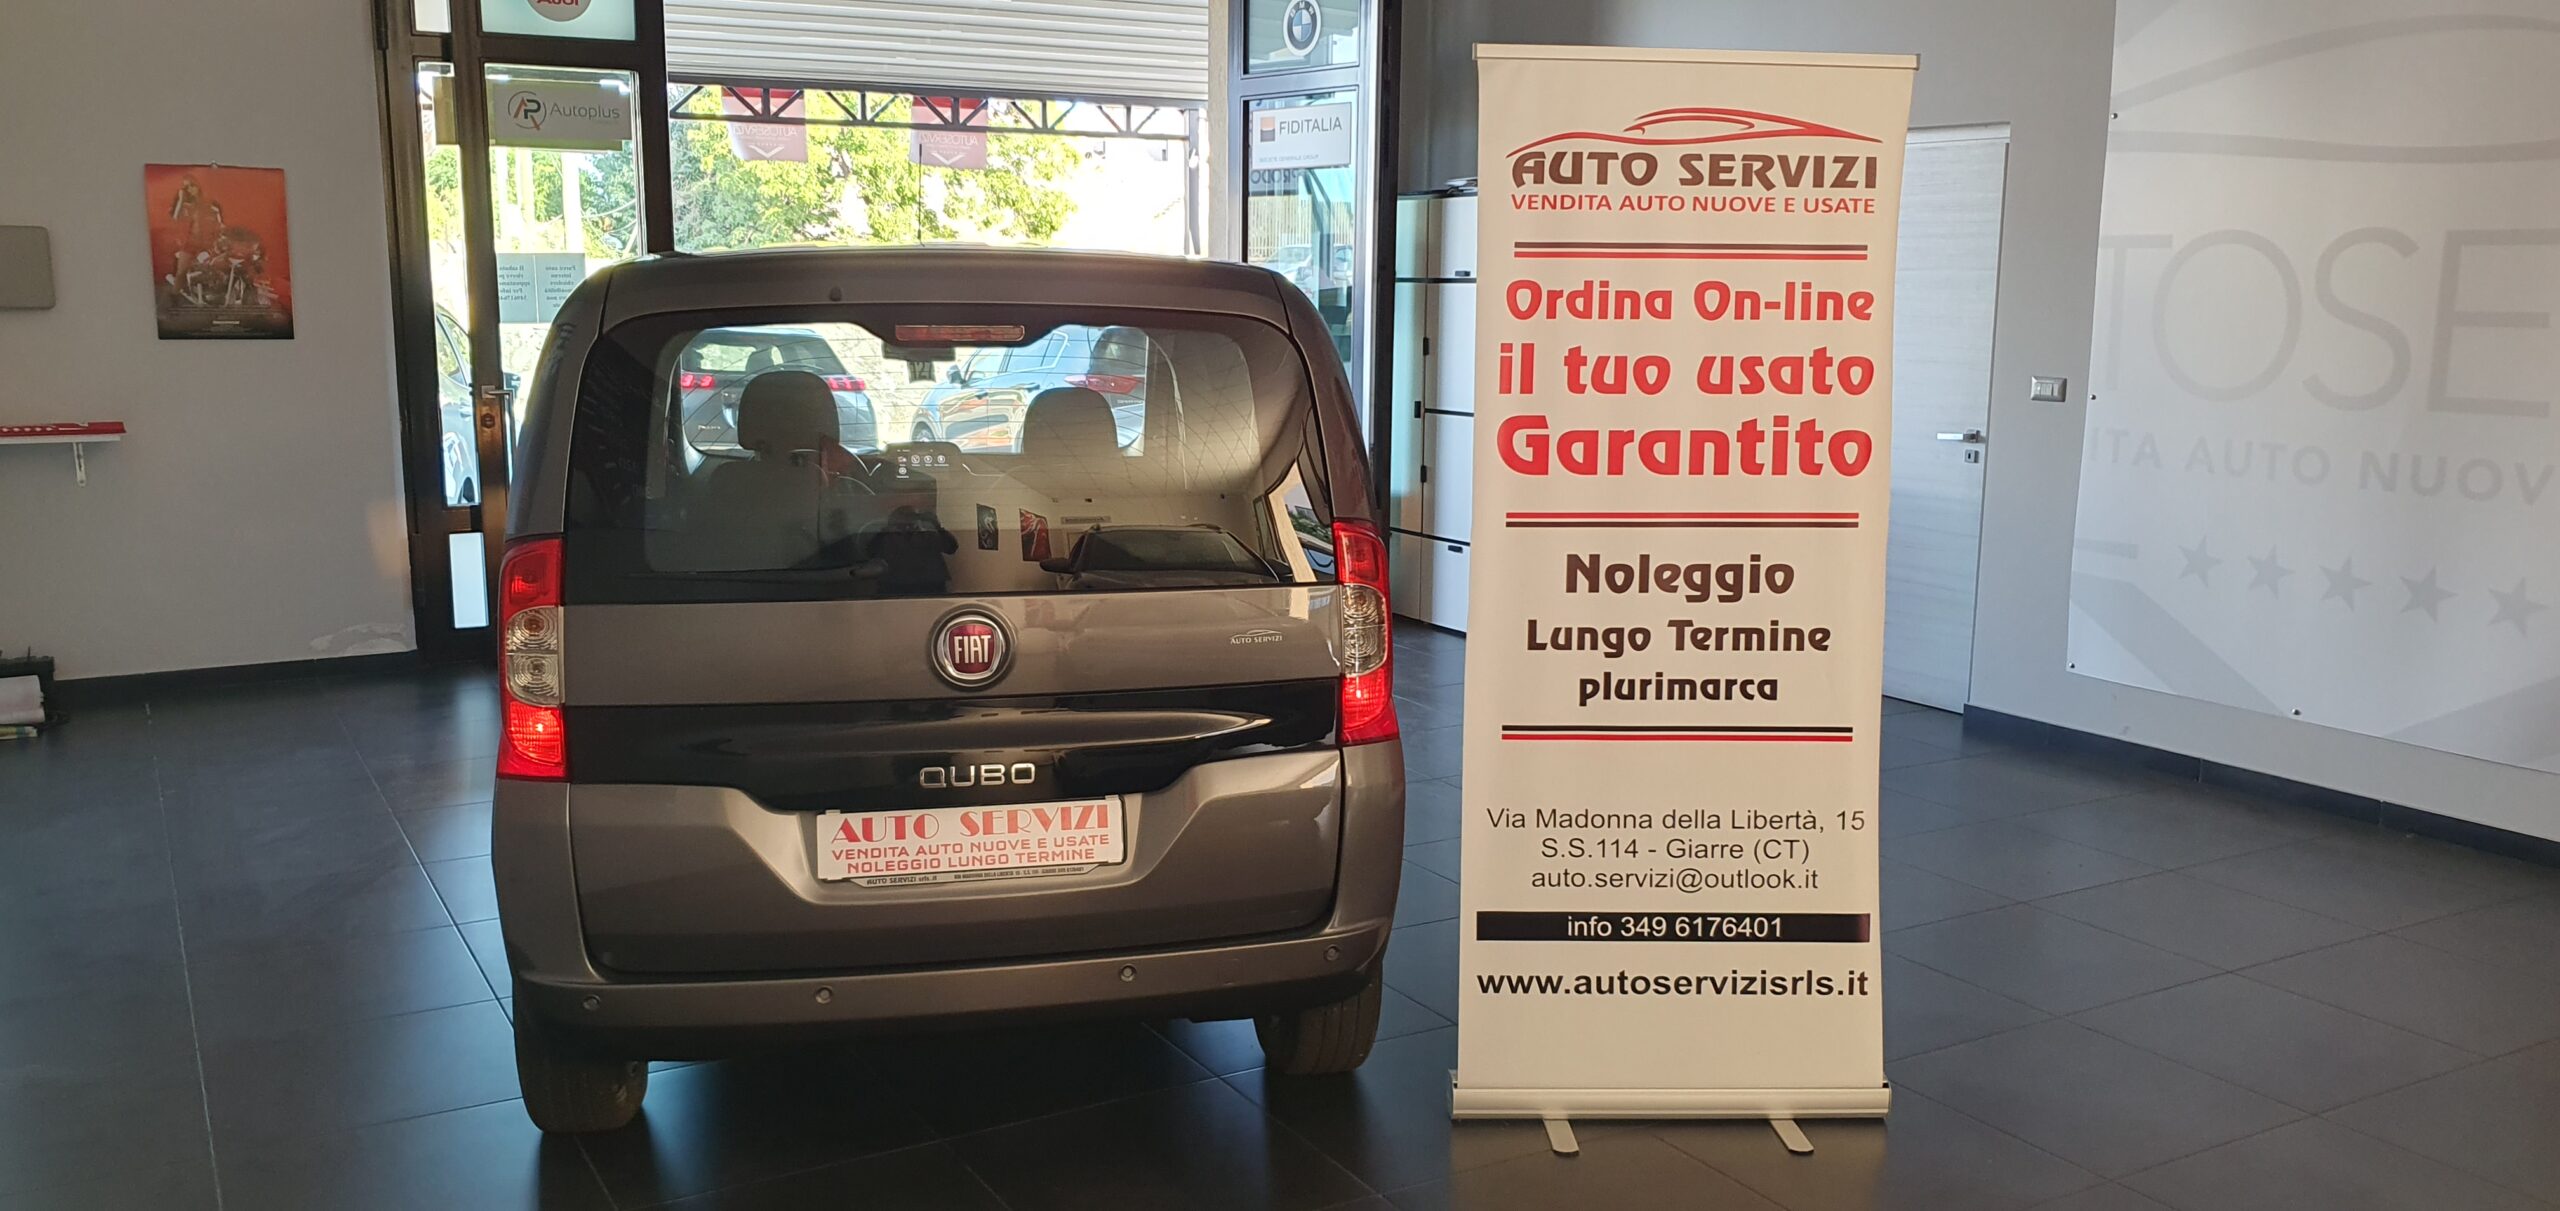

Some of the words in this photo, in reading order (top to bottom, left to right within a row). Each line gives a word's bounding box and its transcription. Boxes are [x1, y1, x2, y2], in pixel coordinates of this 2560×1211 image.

[550, 102, 620, 120] Autoplus
[1279, 117, 1342, 135] FIDITALIA
[1511, 151, 1659, 189] AUTO
[1678, 153, 1878, 192] SERVIZI
[1511, 193, 1613, 211] VENDITA
[1619, 195, 1685, 212] AUTO
[1692, 196, 1776, 213] NUOVE
[1783, 197, 1796, 213] E
[1804, 197, 1876, 214] USATE
[1505, 279, 1673, 321] Ordina
[1693, 280, 1876, 321] On-line
[1499, 342, 1535, 395] il
[1563, 345, 1672, 396] tuo
[1696, 346, 1876, 396] usato
[1496, 414, 1873, 478] Garantito
[2184, 434, 2331, 487] AUTO
[2358, 450, 2557, 507] NUOV
[1565, 553, 1796, 604] Noleggio
[953, 635, 992, 664] FIAT
[1526, 618, 1652, 659] Lungo
[1667, 619, 1832, 653] Termine
[1578, 671, 1779, 708] plurimarca
[919, 762, 1036, 789] QUBO
[831, 812, 940, 845] AUTO
[959, 804, 1109, 838] SERVIZI
[1486, 807, 1527, 830] Via
[1535, 808, 1654, 831] Madonna
[1661, 809, 1722, 831] della
[1730, 808, 1825, 835] Libertà,
[1837, 810, 1866, 832] 15
[831, 845, 910, 861] VENDITA
[916, 842, 964, 857] AUTO
[969, 838, 1032, 854] NUOVE
[1037, 837, 1048, 849] E
[1053, 833, 1111, 849] USATE
[1541, 837, 1639, 860] S.S.114
[1665, 837, 1744, 861] Giarre
[1752, 839, 1811, 865] (CT)
[847, 857, 942, 875] NOLEGGIO
[948, 853, 1010, 868] LUNGO
[1015, 848, 1096, 865] TERMINE
[1531, 867, 1818, 894] auto.servizi@outlook.it
[1567, 916, 1613, 937] info
[1620, 917, 1667, 939] 349
[1675, 917, 1783, 940] 6176401
[1477, 969, 1869, 997] www.autoservizisrls.it
